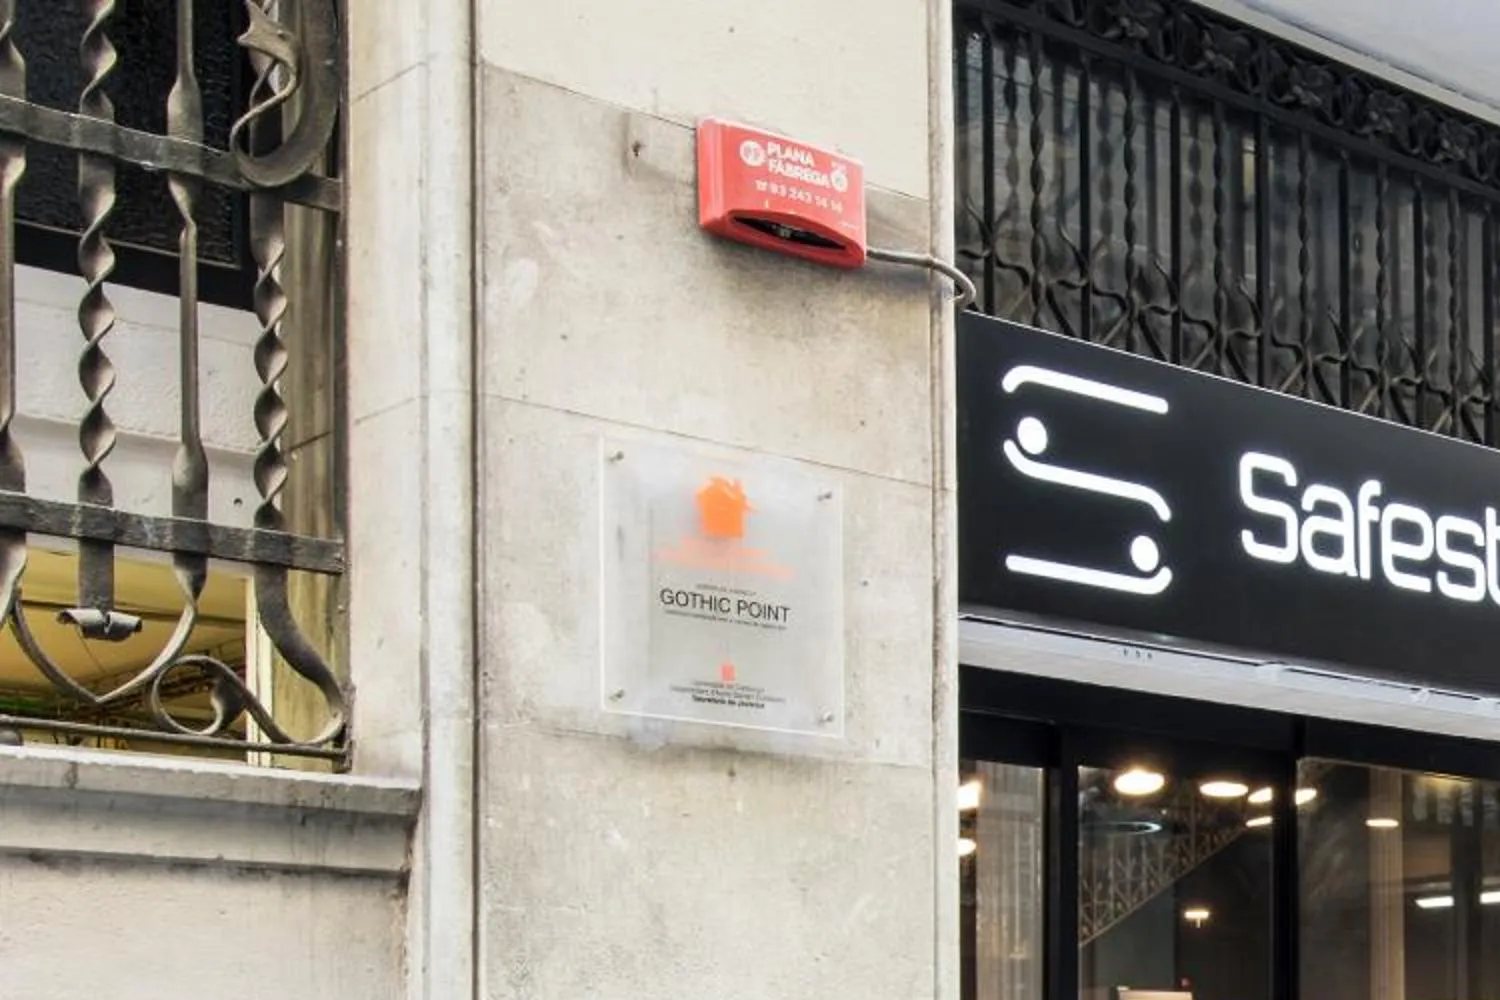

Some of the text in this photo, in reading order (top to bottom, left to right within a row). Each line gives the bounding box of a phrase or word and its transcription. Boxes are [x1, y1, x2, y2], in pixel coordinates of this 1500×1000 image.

[767, 141, 815, 167] PLANA
[660, 588, 731, 613] GOTHIC
[737, 599, 790, 622] POINT
